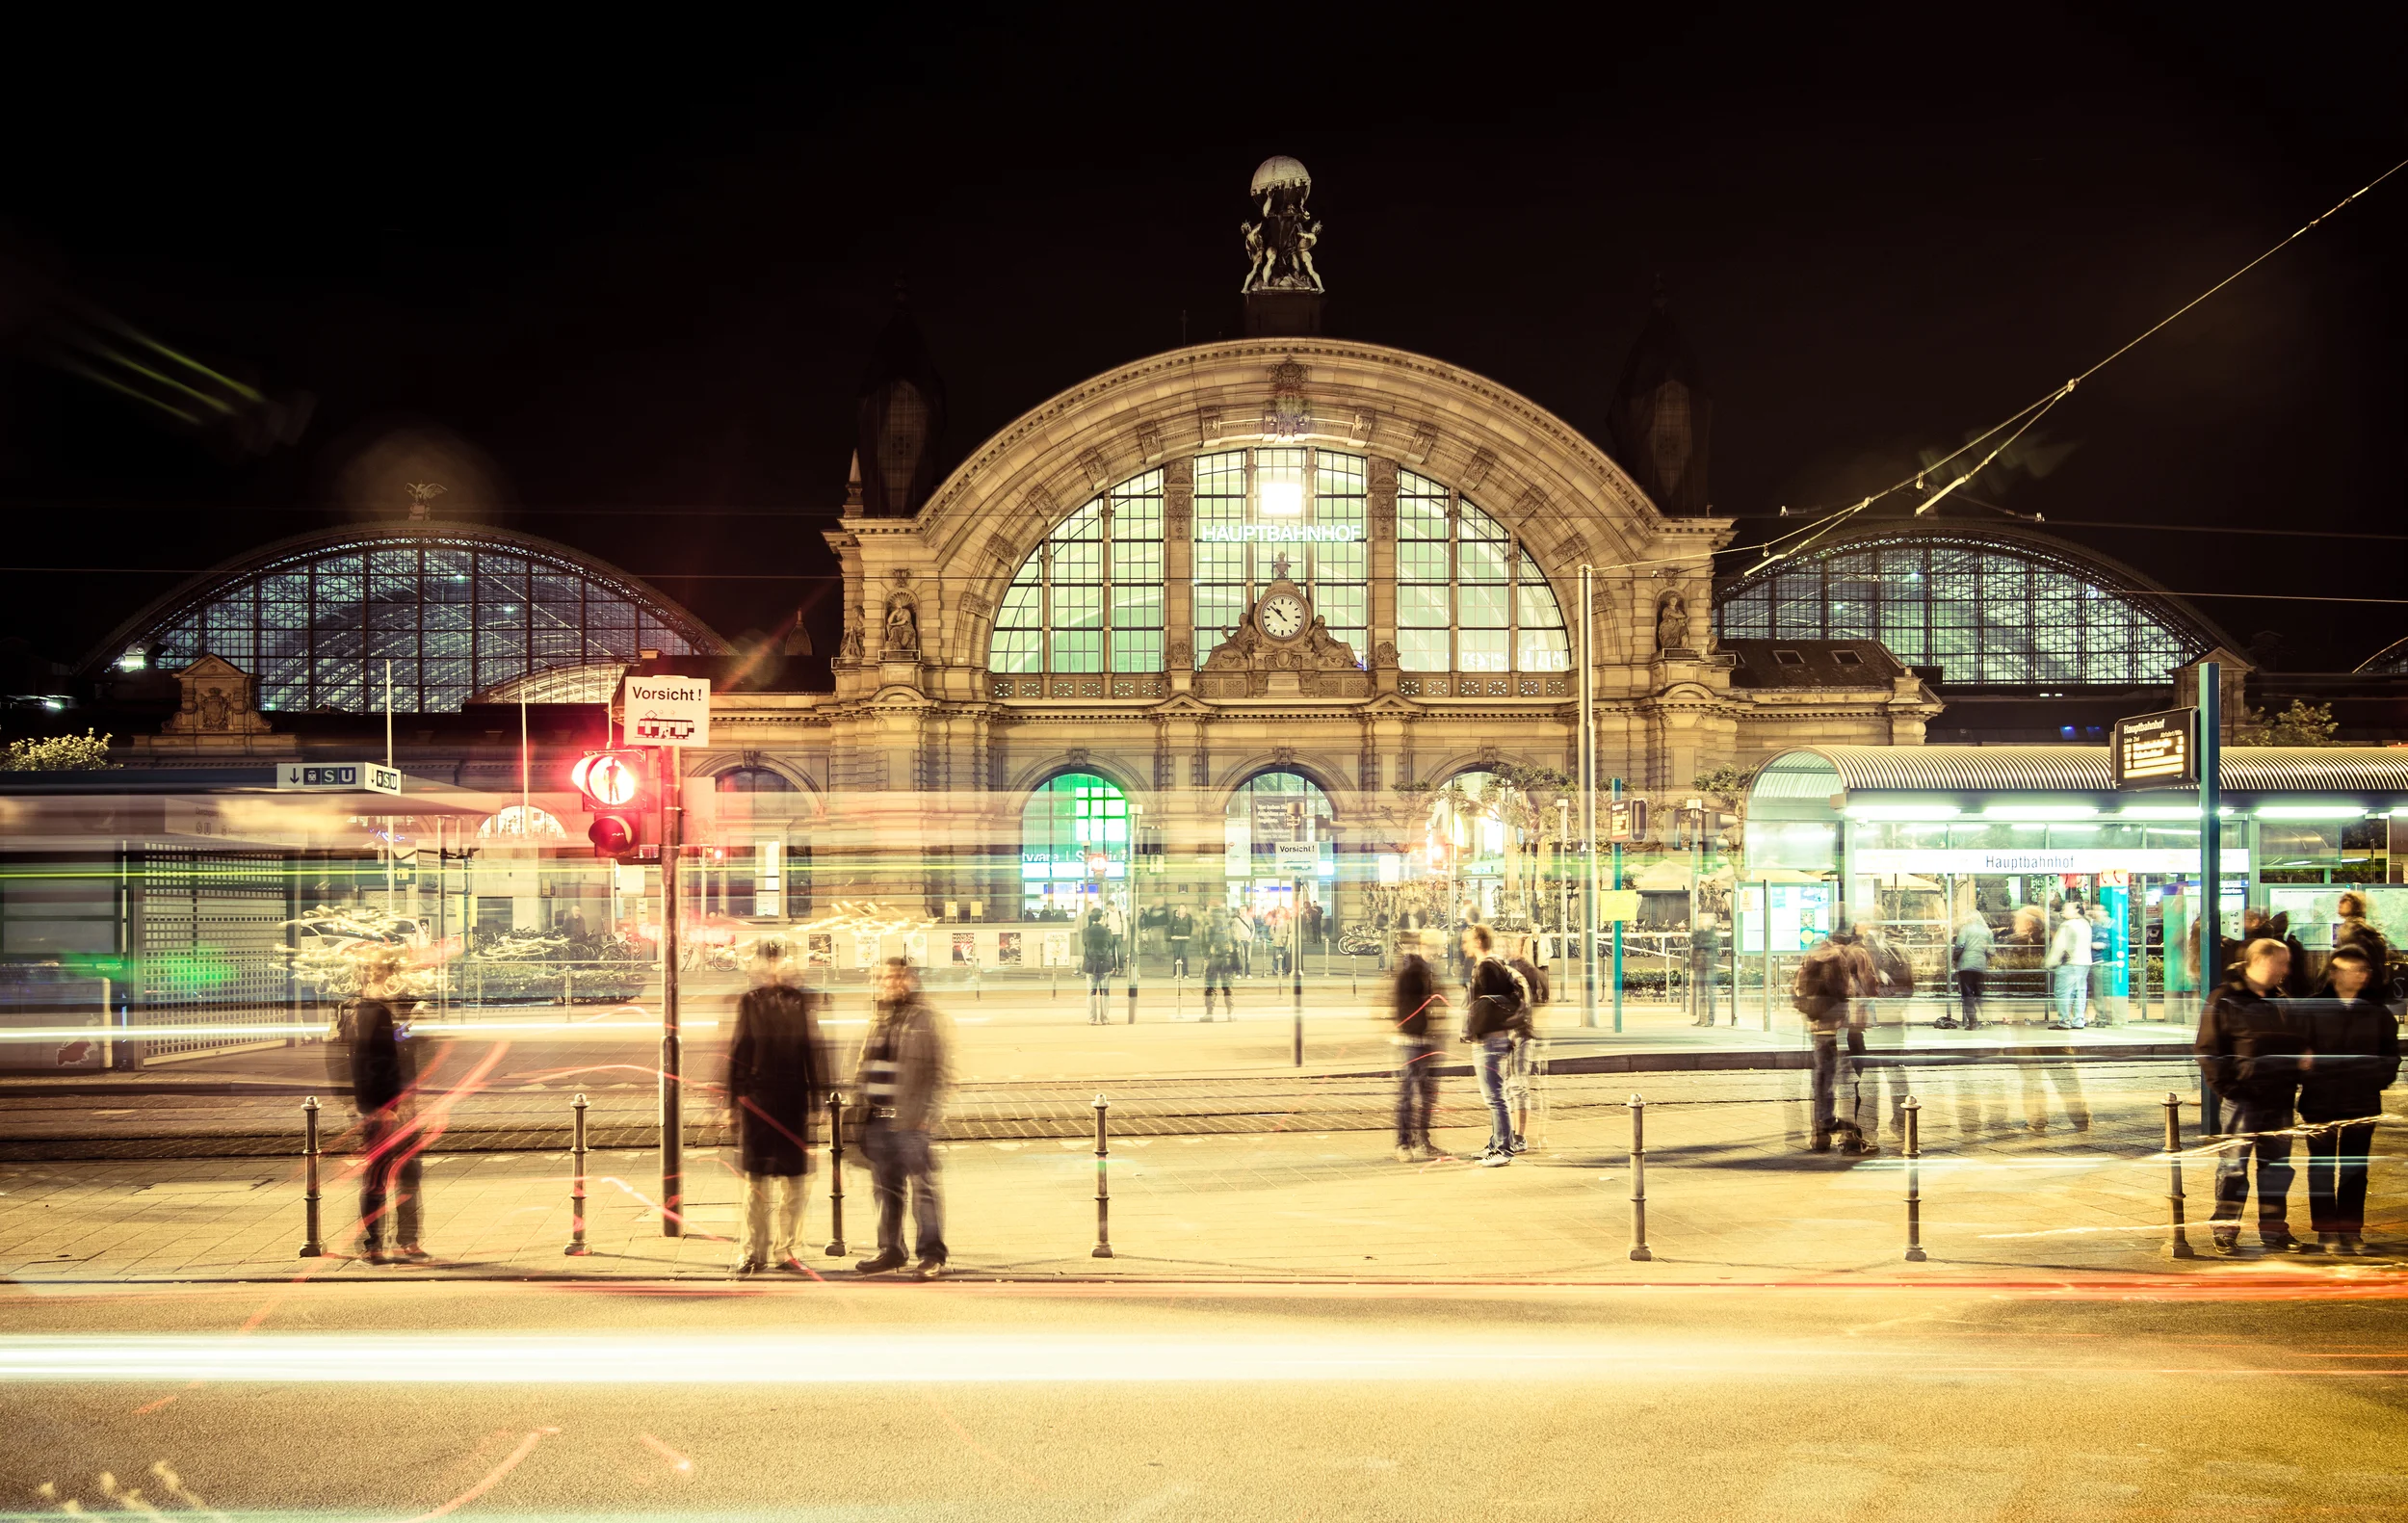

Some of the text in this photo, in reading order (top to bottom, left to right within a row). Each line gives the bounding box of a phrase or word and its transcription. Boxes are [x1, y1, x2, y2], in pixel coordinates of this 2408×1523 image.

[1202, 525, 1362, 542] HAUPTBAHNHOF
[2124, 718, 2165, 734] Hauptbahnhof
[324, 770, 353, 783] S U
[383, 773, 397, 789] S U
[1985, 855, 2074, 871] Hauptbahnhof
